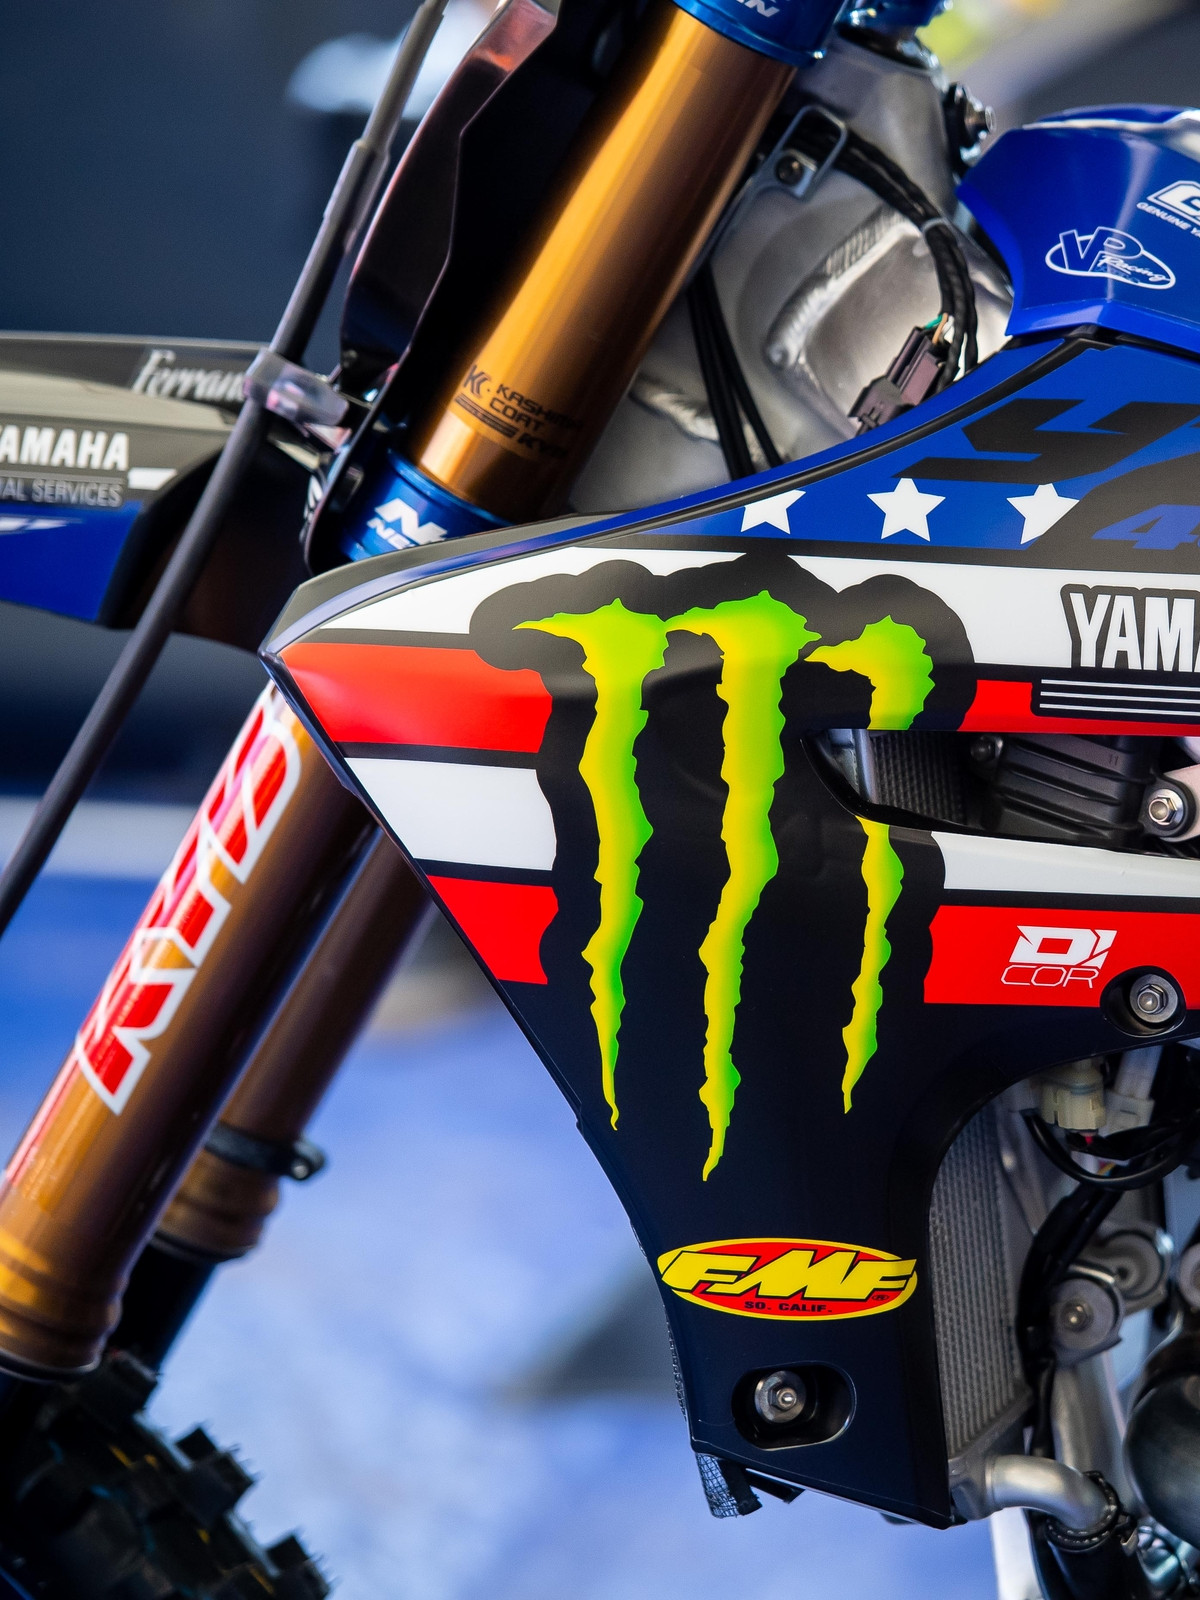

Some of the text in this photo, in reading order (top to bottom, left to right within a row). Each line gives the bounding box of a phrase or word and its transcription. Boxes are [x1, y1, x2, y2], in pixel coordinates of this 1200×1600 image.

[1136, 202, 1194, 231] GENUINE
[1058, 226, 1143, 273] VP
[131, 350, 246, 401] Ferran
[489, 397, 545, 432] COAT
[0, 425, 129, 471] AMAHA
[32, 478, 124, 508] SERVICES
[1000, 964, 1099, 989] COR
